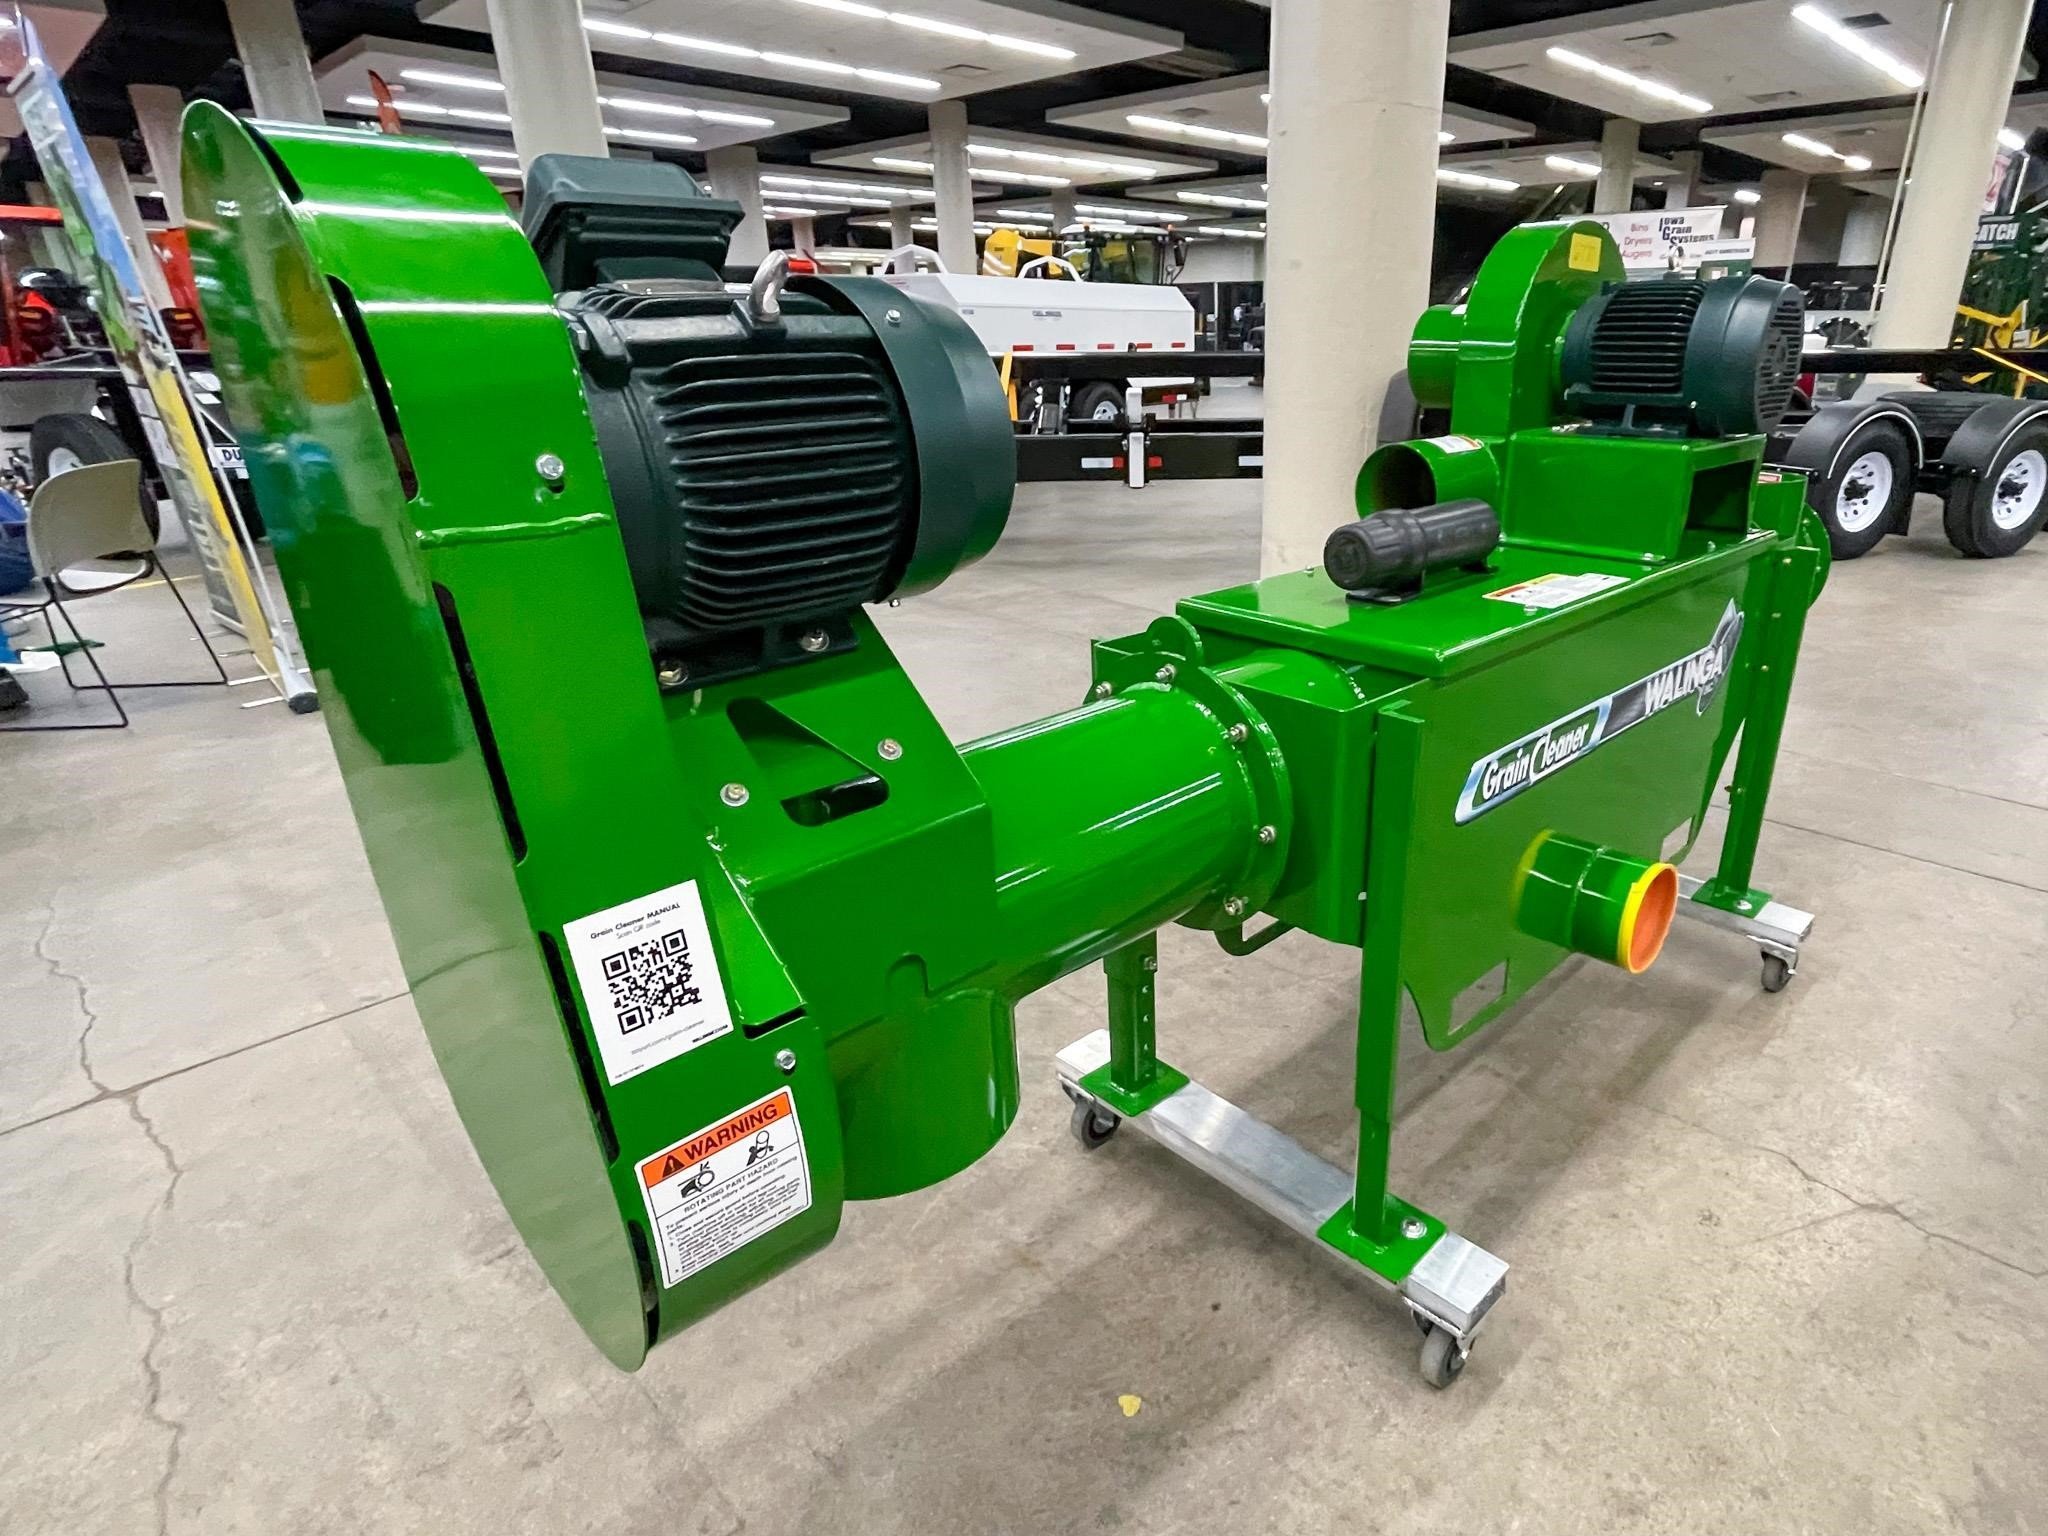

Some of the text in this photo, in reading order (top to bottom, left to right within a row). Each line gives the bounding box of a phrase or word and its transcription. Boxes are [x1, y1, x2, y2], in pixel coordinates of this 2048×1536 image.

[1659, 217, 1684, 232] Iowa
[1662, 226, 1692, 241] Grain
[1976, 223, 2020, 241] ATCH
[221, 449, 241, 460] DU
[1644, 645, 1726, 716] WALINGA
[1482, 722, 1589, 800] Grain Cleaner
[590, 902, 680, 939] Grain Cleaner MANUAL
[616, 918, 661, 939] Scan QR code
[684, 1103, 778, 1160] WARNING
[684, 1157, 778, 1213] ROTATING PART HAZARD
